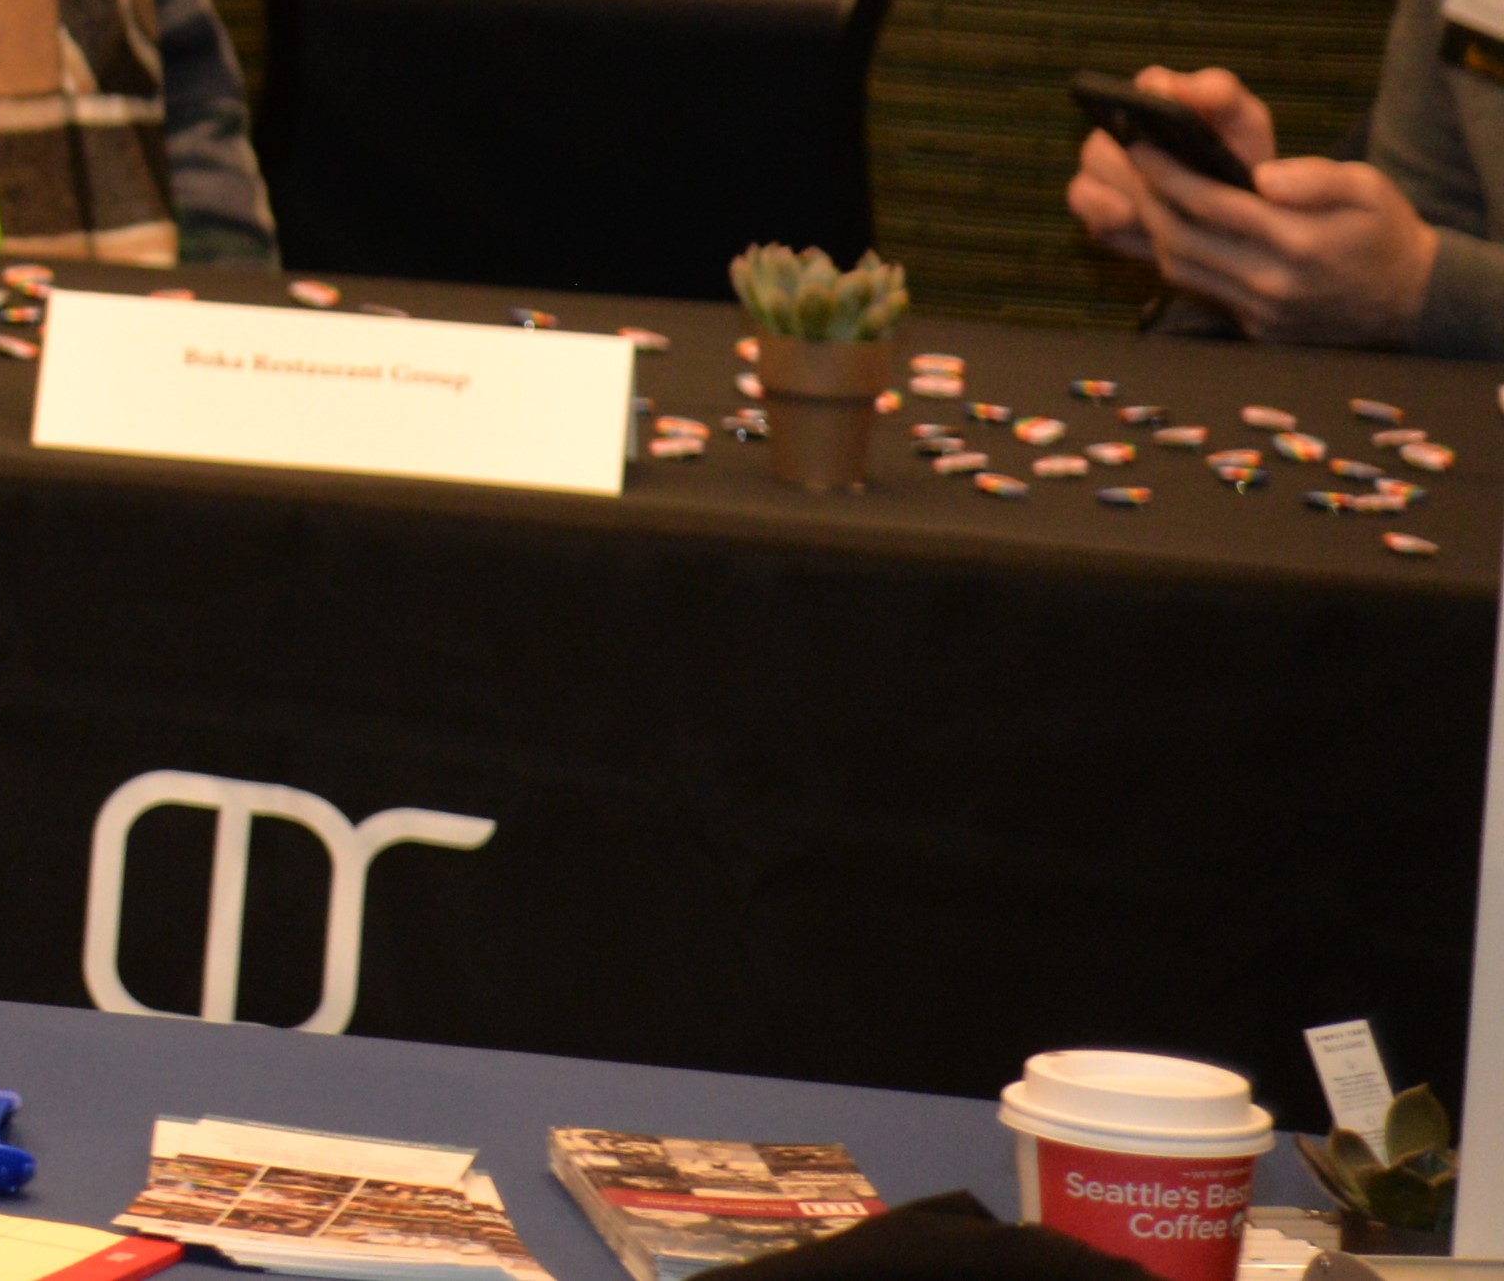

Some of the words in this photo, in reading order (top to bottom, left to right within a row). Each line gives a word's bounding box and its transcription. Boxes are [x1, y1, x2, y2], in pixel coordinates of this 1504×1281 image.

[252, 352, 383, 382] Restaurant
[390, 363, 471, 392] Group
[1065, 1171, 1200, 1209] Seattle's
[1206, 1183, 1251, 1209] Bes
[1129, 1212, 1228, 1240] Coffee
